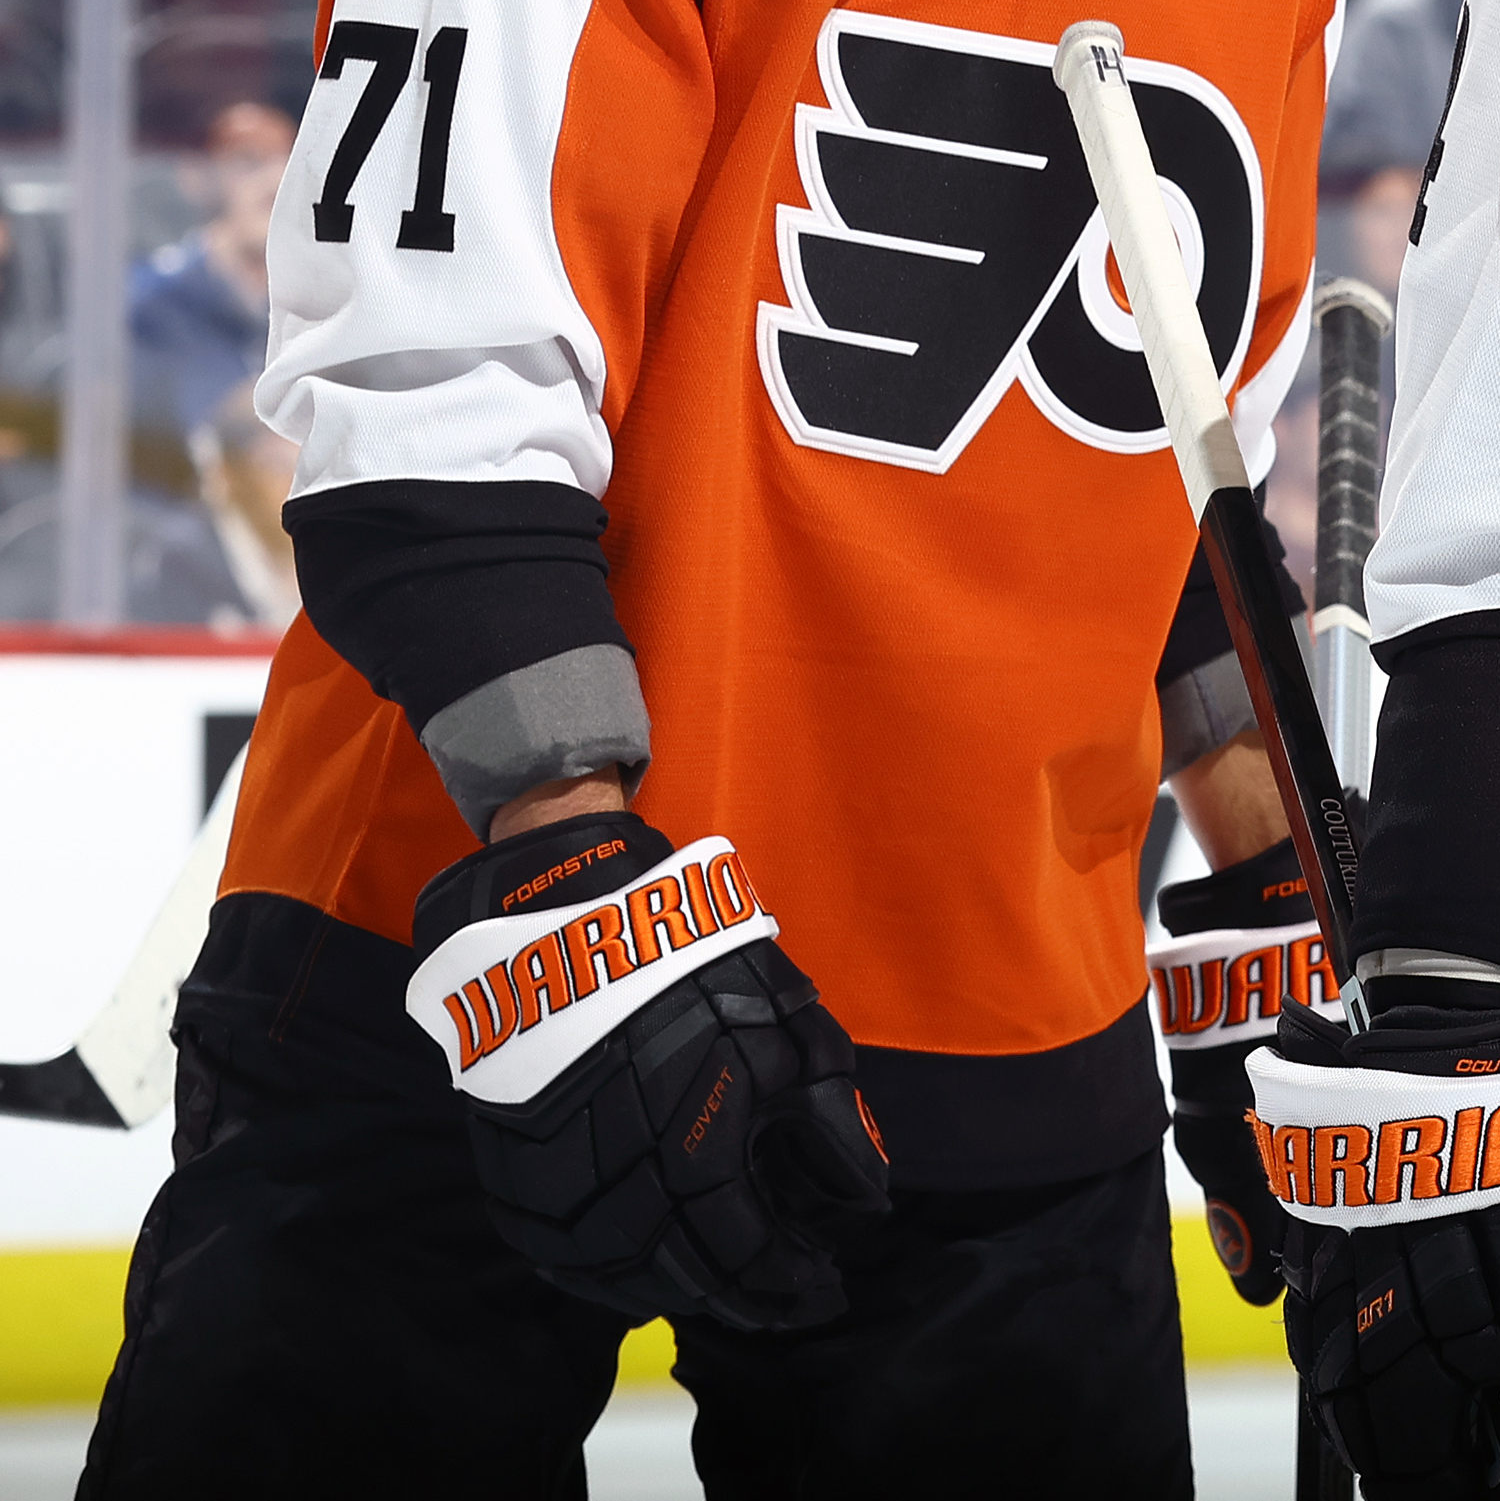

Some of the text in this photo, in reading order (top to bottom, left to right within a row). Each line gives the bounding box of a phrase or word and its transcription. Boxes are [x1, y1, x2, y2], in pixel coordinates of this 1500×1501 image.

[1090, 45, 1127, 86] 14
[313, 21, 470, 253] 71
[502, 840, 627, 912] FOERSTER
[683, 1066, 734, 1154] COVERT
[1357, 1289, 1395, 1333] QR1
